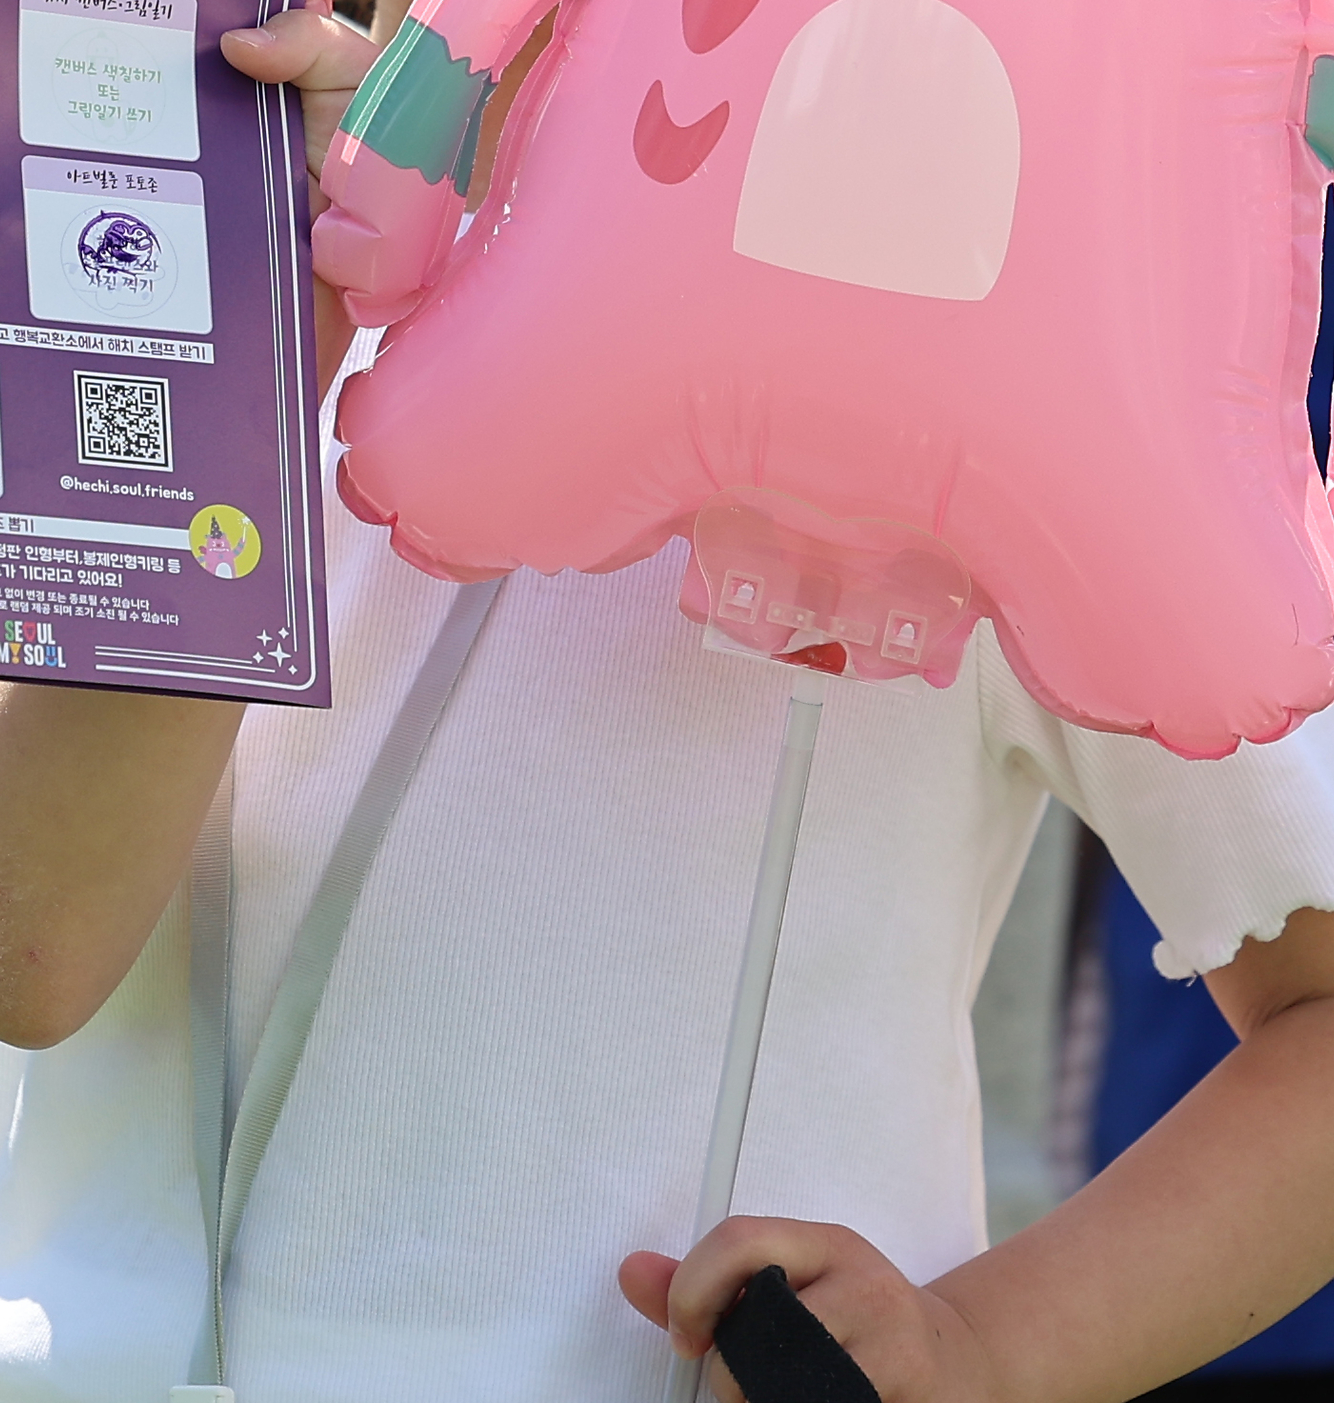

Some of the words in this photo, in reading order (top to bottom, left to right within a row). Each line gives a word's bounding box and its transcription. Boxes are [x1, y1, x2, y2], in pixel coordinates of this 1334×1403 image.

[55, 58, 97, 77] 캔버스
[102, 64, 161, 84] 색칠하기
[97, 84, 120, 102] 또는
[68, 101, 121, 121] 그림일기
[126, 108, 152, 123] 쓰기
[67, 169, 118, 190] 아트벌룬
[125, 174, 158, 193] 포토존
[88, 275, 117, 291] 사진
[122, 276, 153, 294] 찍기
[13, 329, 103, 350] 행복교환소에서
[107, 338, 134, 353] 해치
[138, 341, 176, 356] 스탬프
[179, 345, 206, 360] 받기
[60, 475, 194, 501] @hechi.soul.friends
[8, 517, 34, 533] 뽑기
[19, 565, 73, 584] 기다리고
[77, 569, 123, 588] 있어요!
[168, 558, 181, 575] 등
[4, 587, 24, 599] 없이
[26, 589, 45, 602] 변경
[48, 591, 66, 604] 또는
[100, 596, 109, 607] 수
[112, 597, 149, 611] 있습니다
[10, 600, 29, 613] 랜덤
[32, 602, 50, 615] 제공
[75, 606, 94, 618] 조기
[96, 608, 115, 621] 소진
[129, 611, 139, 622] 수
[141, 611, 179, 626] 있습니다
